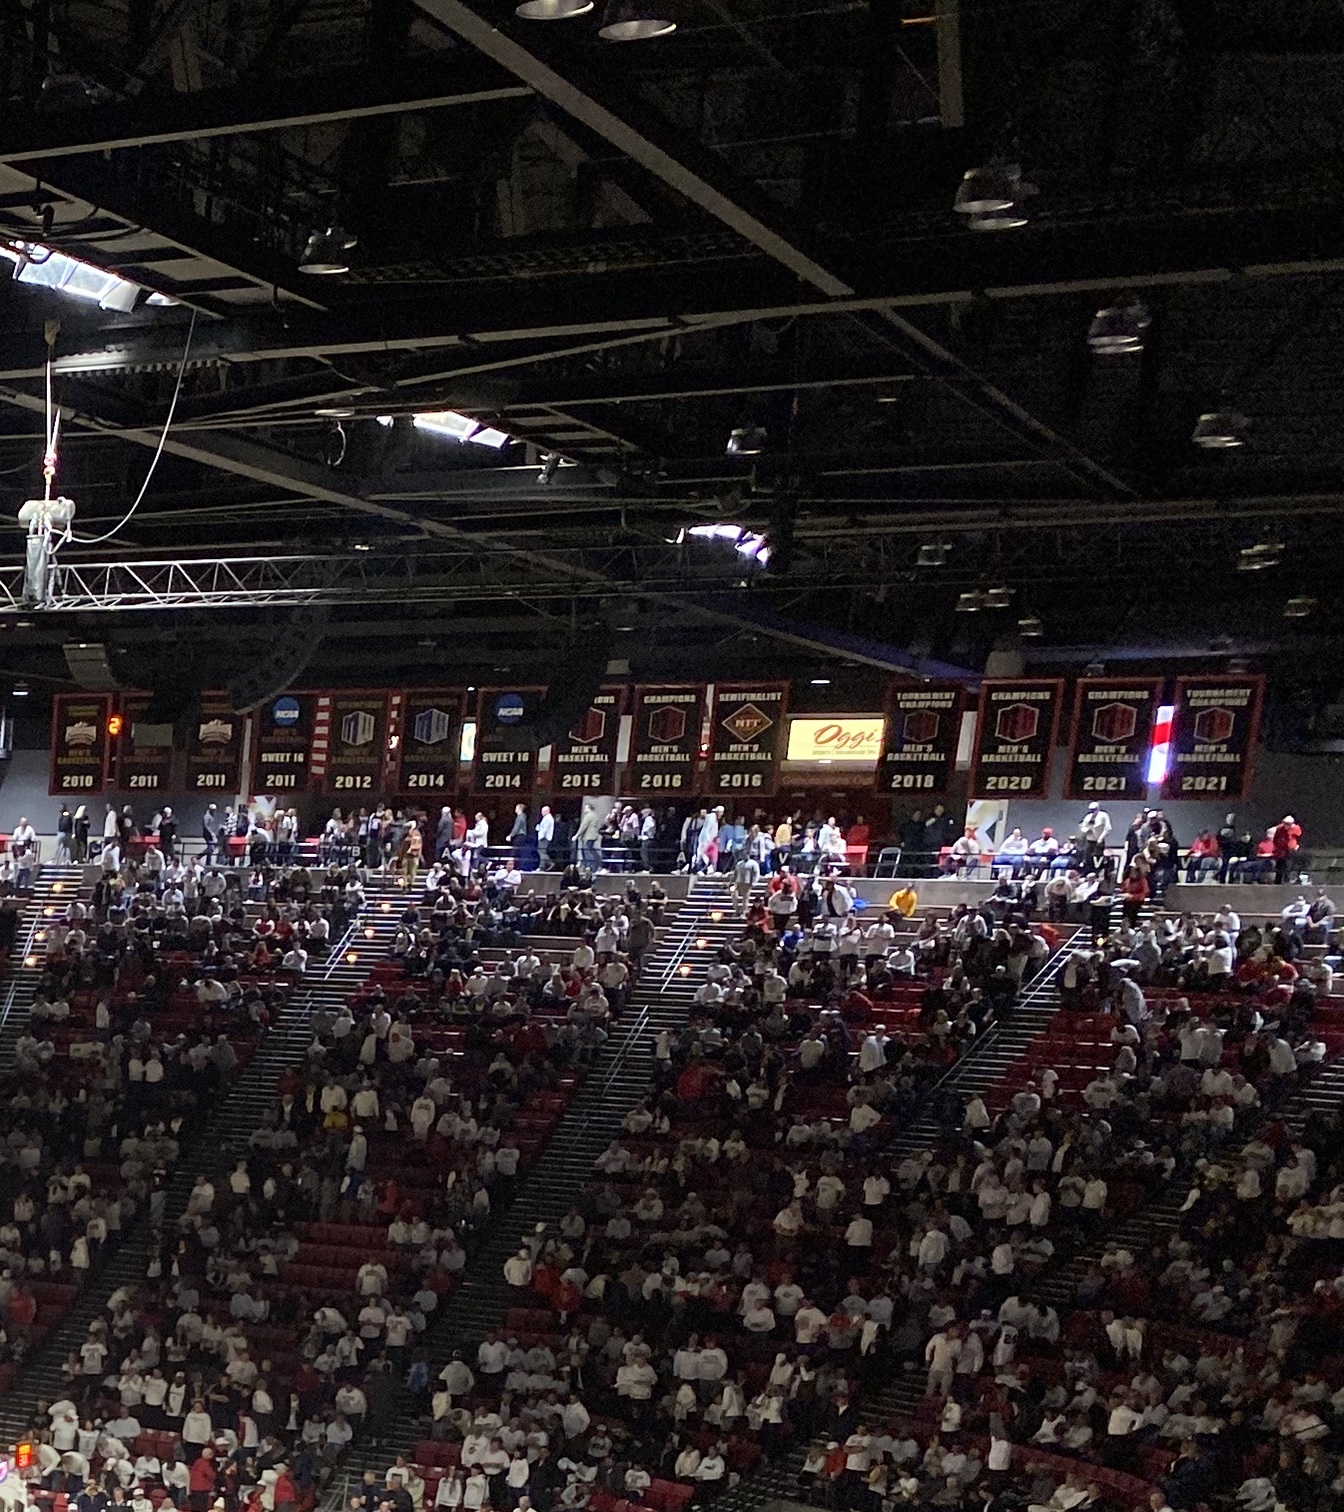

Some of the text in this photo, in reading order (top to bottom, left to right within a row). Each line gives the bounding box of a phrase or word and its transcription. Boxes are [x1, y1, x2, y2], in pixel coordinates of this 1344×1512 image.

[718, 692, 782, 703] SEMIFINALIST
[990, 691, 1051, 701] CHAMPIONS
[1087, 690, 1150, 700] CHAMPIONS
[1186, 688, 1253, 698] TOURNAMENT
[643, 694, 696, 704] CHAMPIONS
[813, 724, 885, 750] Oggi
[728, 744, 760, 754] MEN'S
[997, 745, 1029, 754] MEN'S
[1093, 744, 1127, 754] MEN'S
[1193, 744, 1229, 753] MEN'S
[261, 753, 292, 763] SWEET
[481, 753, 515, 763] SWEET
[557, 754, 609, 763] BASKETBALL
[636, 754, 690, 763] BASKETBALL
[713, 752, 773, 762] BASKETBALL
[886, 752, 946, 762] BASKETBALL
[981, 753, 1042, 763] BASKETBALL
[1077, 753, 1141, 763] BASKETBALL
[1176, 753, 1241, 763] BASKETBALL
[61, 775, 94, 788] 2010
[129, 775, 160, 788] 2011
[196, 774, 227, 787] 2011
[265, 774, 297, 787] 2011
[334, 776, 372, 789] 2012
[407, 774, 445, 788] 2014
[484, 774, 521, 788] 2014
[561, 774, 601, 788] 2015
[640, 774, 683, 788] 2016
[718, 774, 762, 788] 2016
[890, 774, 935, 788] 2018
[985, 776, 1033, 790] 2020
[1082, 776, 1127, 790] 2021
[1181, 776, 1228, 790] 2021
